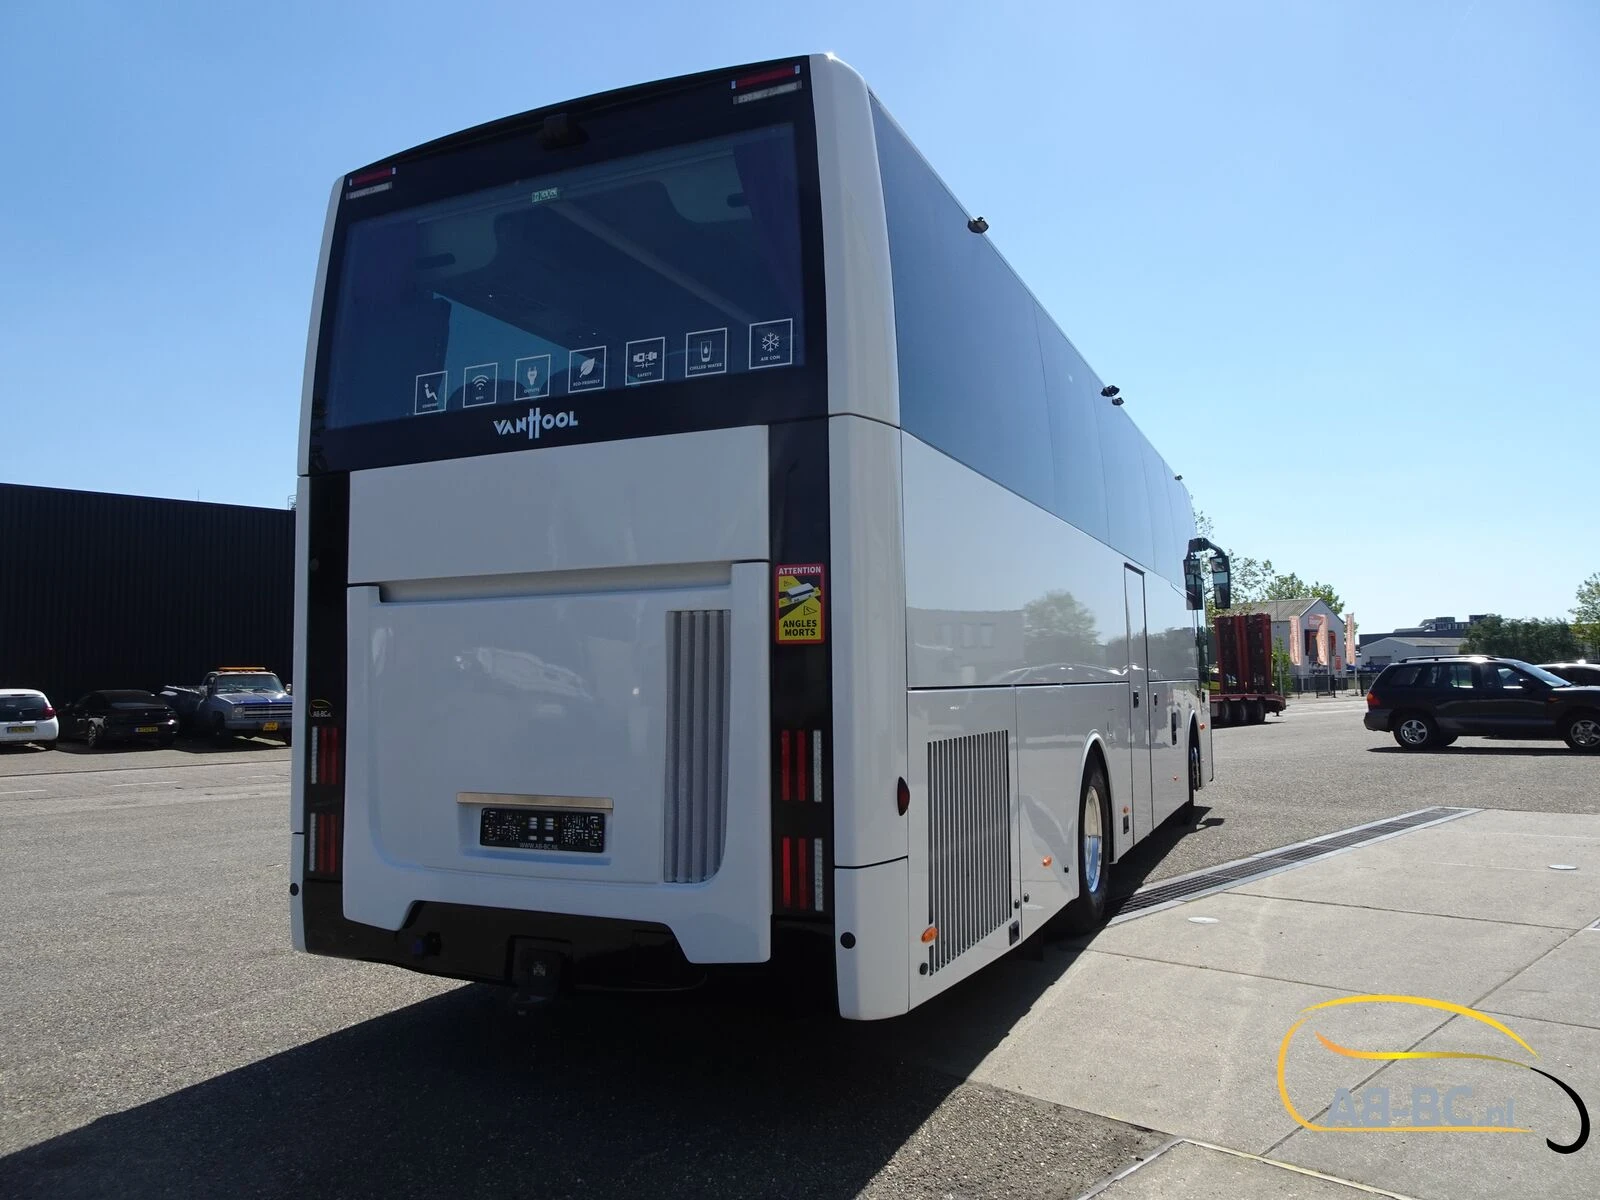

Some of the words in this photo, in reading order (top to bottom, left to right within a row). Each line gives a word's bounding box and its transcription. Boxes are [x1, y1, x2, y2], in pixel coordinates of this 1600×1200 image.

[779, 566, 821, 574] ATTENTION
[783, 619, 817, 628] ANGLES
[784, 628, 816, 637] MORTS
